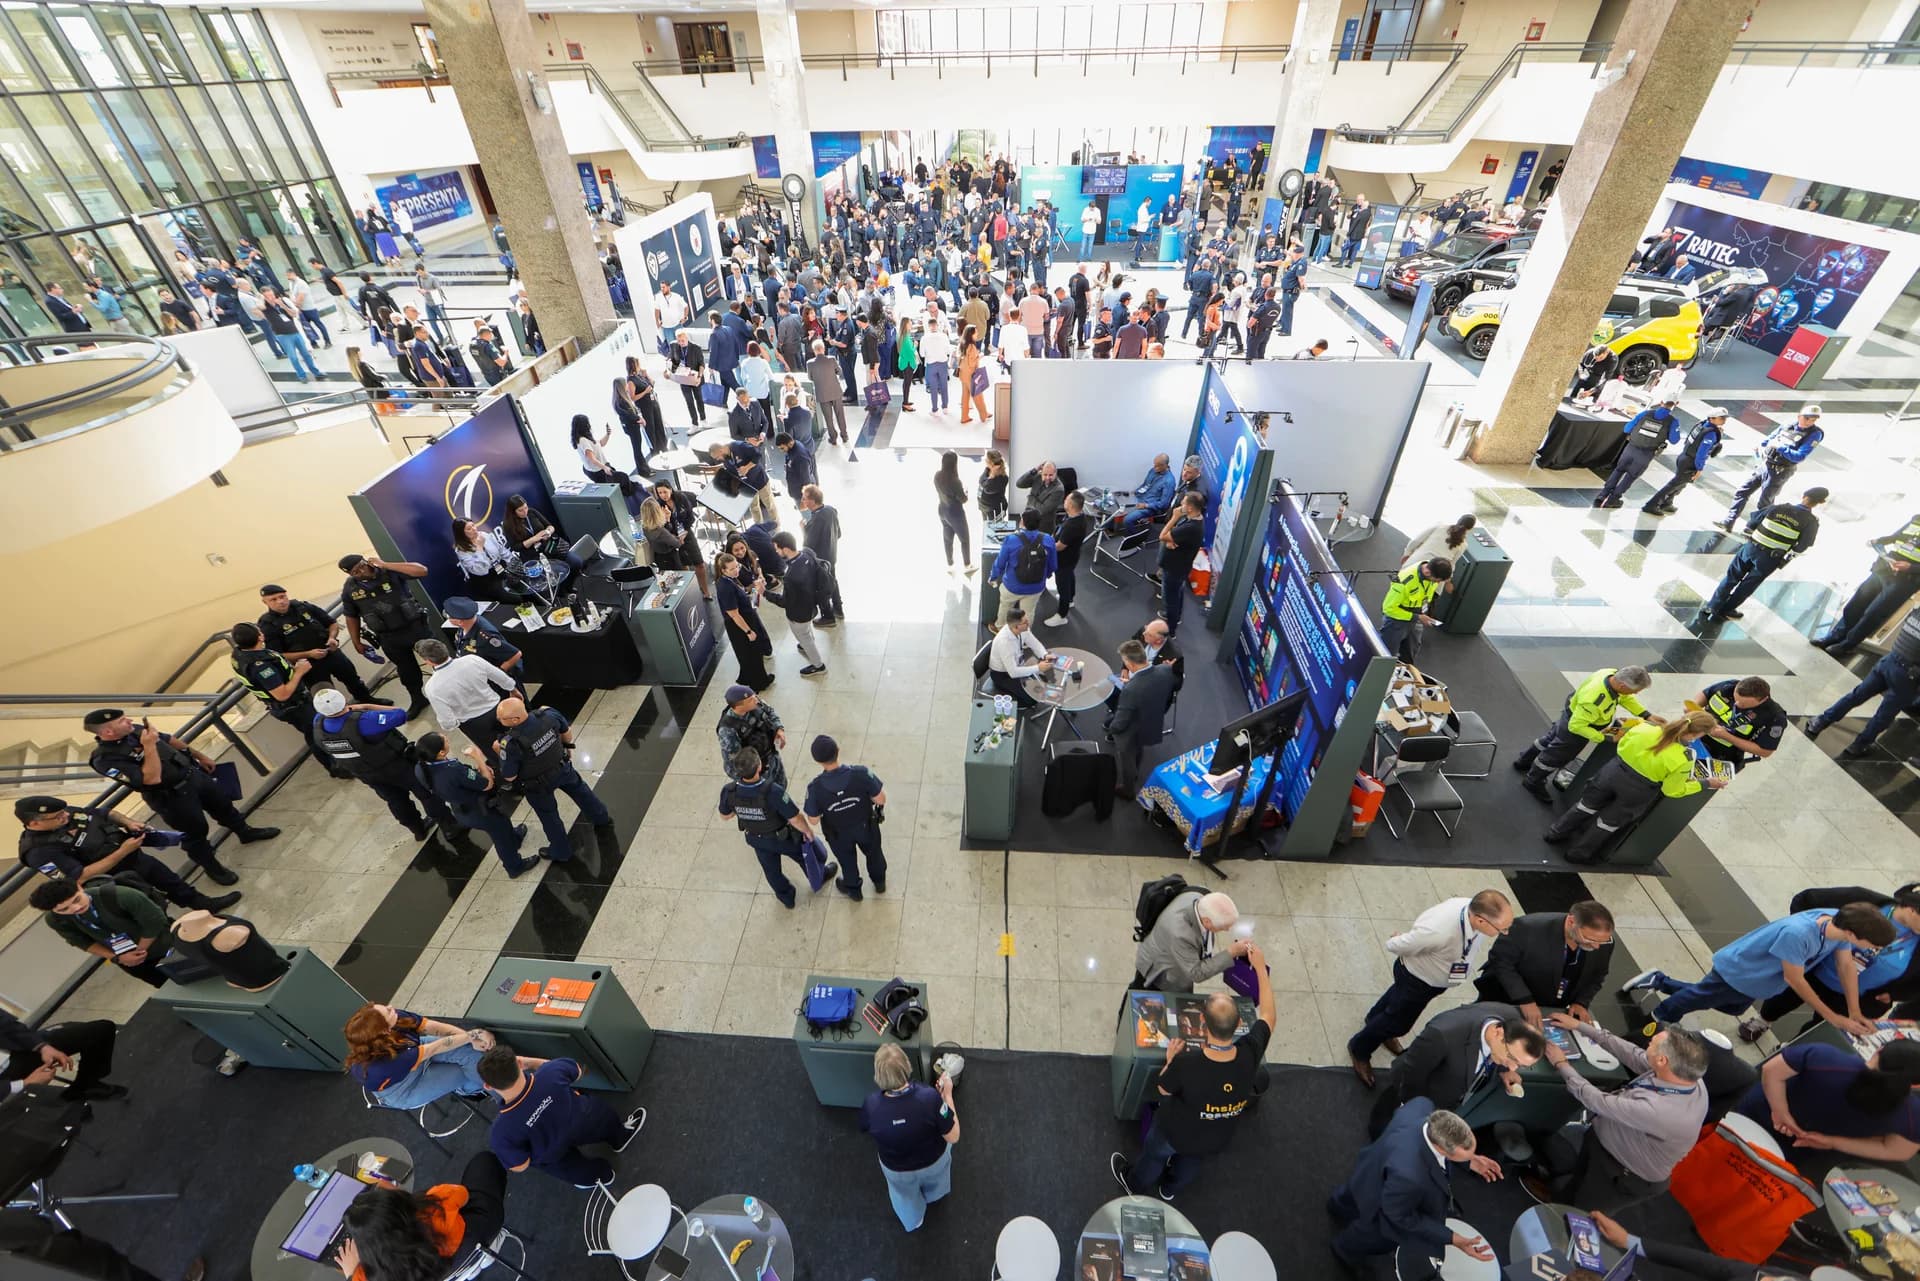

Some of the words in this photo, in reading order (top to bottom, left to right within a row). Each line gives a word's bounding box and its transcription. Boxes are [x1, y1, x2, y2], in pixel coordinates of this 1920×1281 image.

[1687, 236, 1741, 266] RAYTEC
[1313, 582, 1326, 606] DNA
[1343, 637, 1356, 660] IoT
[532, 729, 555, 750] GUARDA
[735, 806, 764, 816] GUARDA
[526, 1096, 551, 1125] INOVAÇÃO
